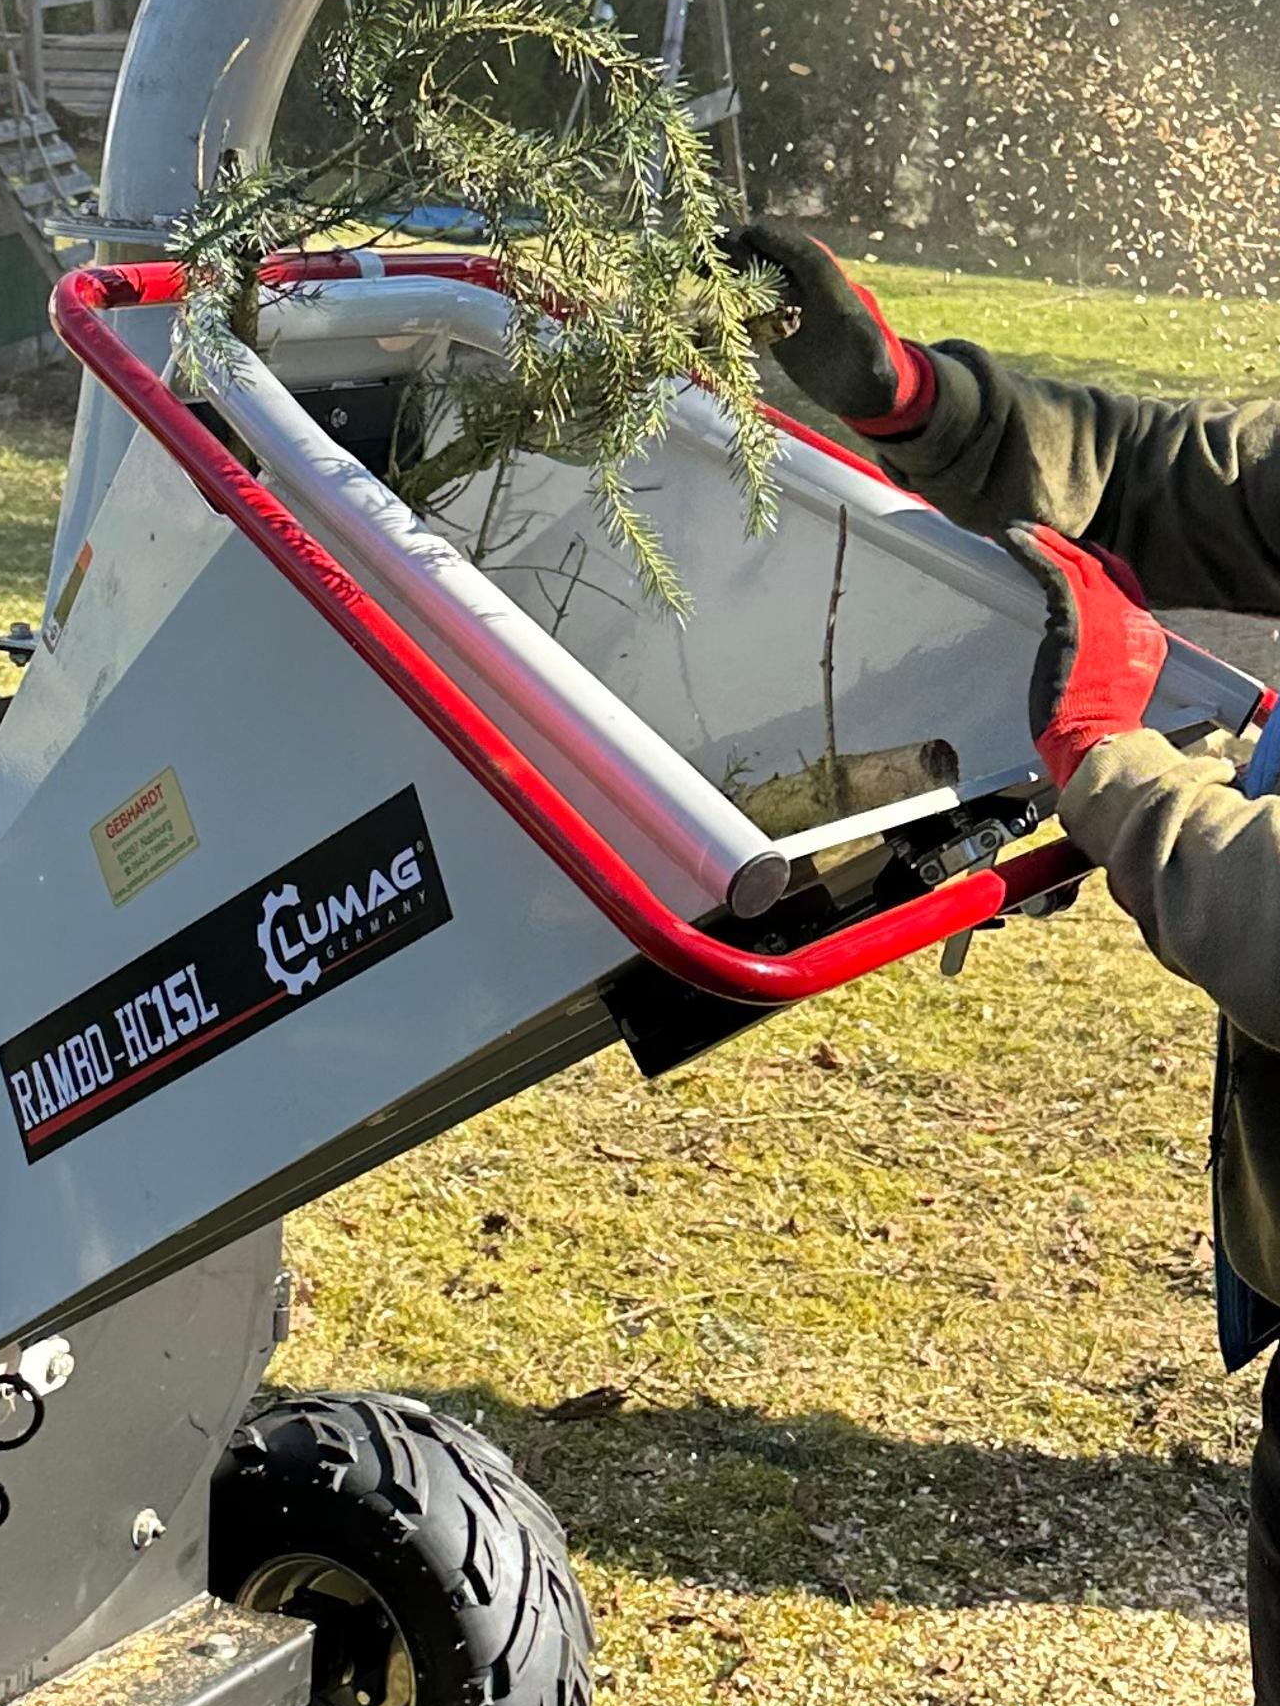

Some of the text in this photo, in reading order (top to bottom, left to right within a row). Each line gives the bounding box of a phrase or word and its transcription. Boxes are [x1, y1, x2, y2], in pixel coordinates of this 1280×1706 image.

[105, 783, 164, 839] GEBHARDT
[326, 890, 426, 959] GERMANY
[10, 962, 219, 1131] RAMBO-HC15L
